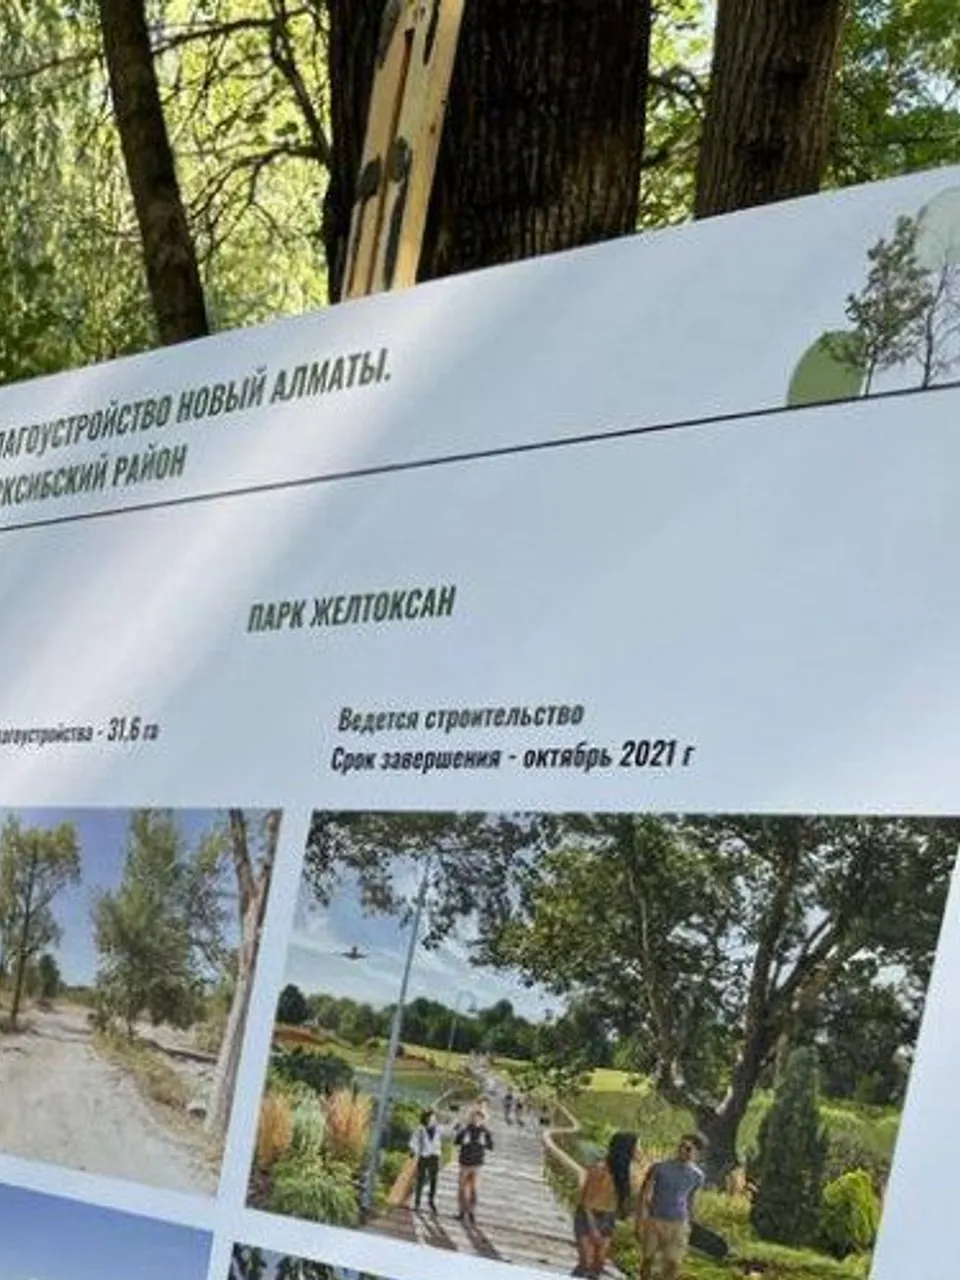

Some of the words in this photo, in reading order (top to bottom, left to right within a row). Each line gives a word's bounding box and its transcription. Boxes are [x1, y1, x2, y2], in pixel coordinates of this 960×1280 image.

[176, 365, 267, 424] НОВЫЙ
[269, 347, 391, 404] АЛМАТЫ.
[112, 444, 189, 488] РАЙОН
[247, 600, 306, 633] ПАРК
[309, 584, 457, 629] ЖЕЛТОКСАН
[338, 706, 419, 735] Ведется
[423, 703, 586, 734] строительство
[330, 746, 376, 776] Срок
[378, 748, 502, 775] завершения
[522, 741, 613, 772] октябрь
[618, 739, 677, 768] 2021
[681, 743, 696, 768] г
